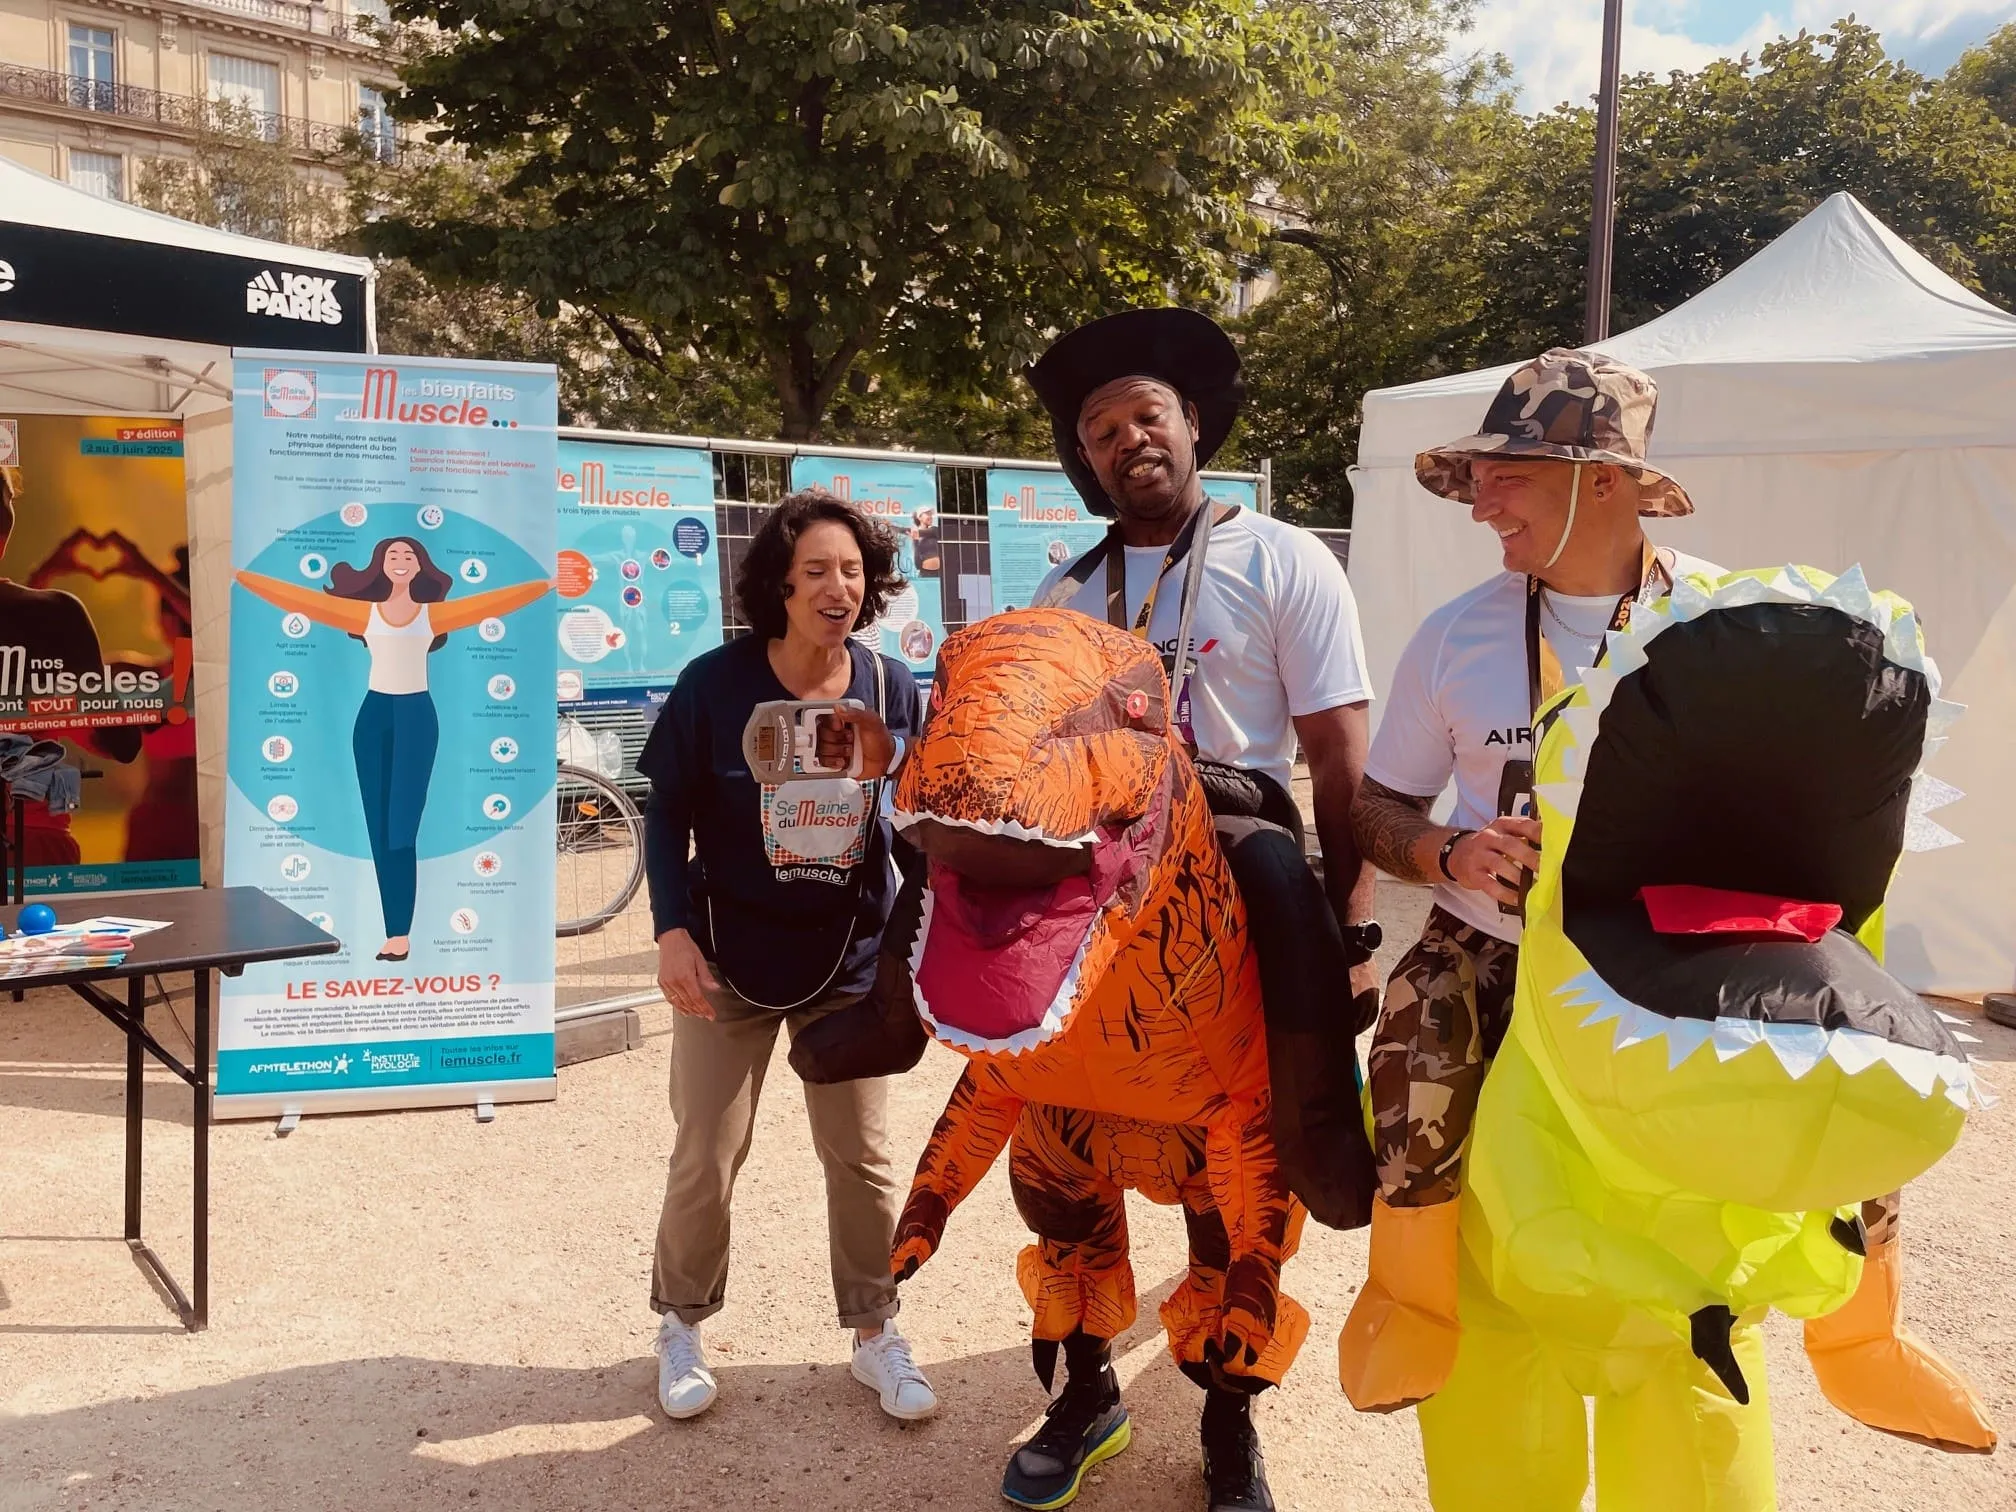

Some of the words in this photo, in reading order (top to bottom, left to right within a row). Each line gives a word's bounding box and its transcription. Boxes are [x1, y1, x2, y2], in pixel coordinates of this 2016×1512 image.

[281, 272, 336, 300] 10K
[247, 288, 342, 325] PARIS
[401, 385, 418, 397] les
[421, 379, 516, 401] bienfaits
[342, 407, 360, 419] du
[136, 430, 176, 440] édition
[286, 431, 308, 439] Notre
[310, 431, 344, 442] mobilité,
[346, 433, 367, 442] notre
[368, 434, 397, 443] activité
[122, 444, 144, 454] juin
[147, 445, 173, 455] 2025
[288, 439, 324, 449] physique
[326, 441, 368, 451] dépendent
[370, 442, 379, 451] du
[382, 443, 397, 452] bon
[269, 448, 332, 458] fonctionnement
[334, 449, 344, 458] de
[345, 452, 360, 460] nos
[362, 451, 397, 461] muscles.
[410, 447, 428, 455] Mais
[430, 448, 444, 456] pas
[446, 449, 485, 458] seulement
[487, 459, 499, 467] est
[409, 465, 428, 474] pour
[445, 465, 481, 475] fonctions
[1003, 491, 1017, 509] le
[563, 507, 579, 515] trois
[581, 508, 601, 517] types
[602, 508, 611, 516] de
[612, 509, 640, 517] muscles
[670, 622, 681, 635] 2
[31, 658, 64, 669] nos
[31, 698, 74, 712] TOUT
[81, 700, 118, 712] pour
[124, 698, 163, 709] nous
[20, 720, 67, 730] science
[70, 717, 89, 727] est
[92, 715, 122, 726] notre
[126, 713, 157, 724] alliée
[1485, 727, 1532, 746] AIR
[779, 817, 797, 829] du
[796, 800, 860, 829] Muscle
[287, 981, 317, 1000] LE
[324, 974, 481, 999] SAVEZ-VOUS
[487, 974, 501, 991] ?
[441, 1052, 522, 1067] lemuscle.fr
